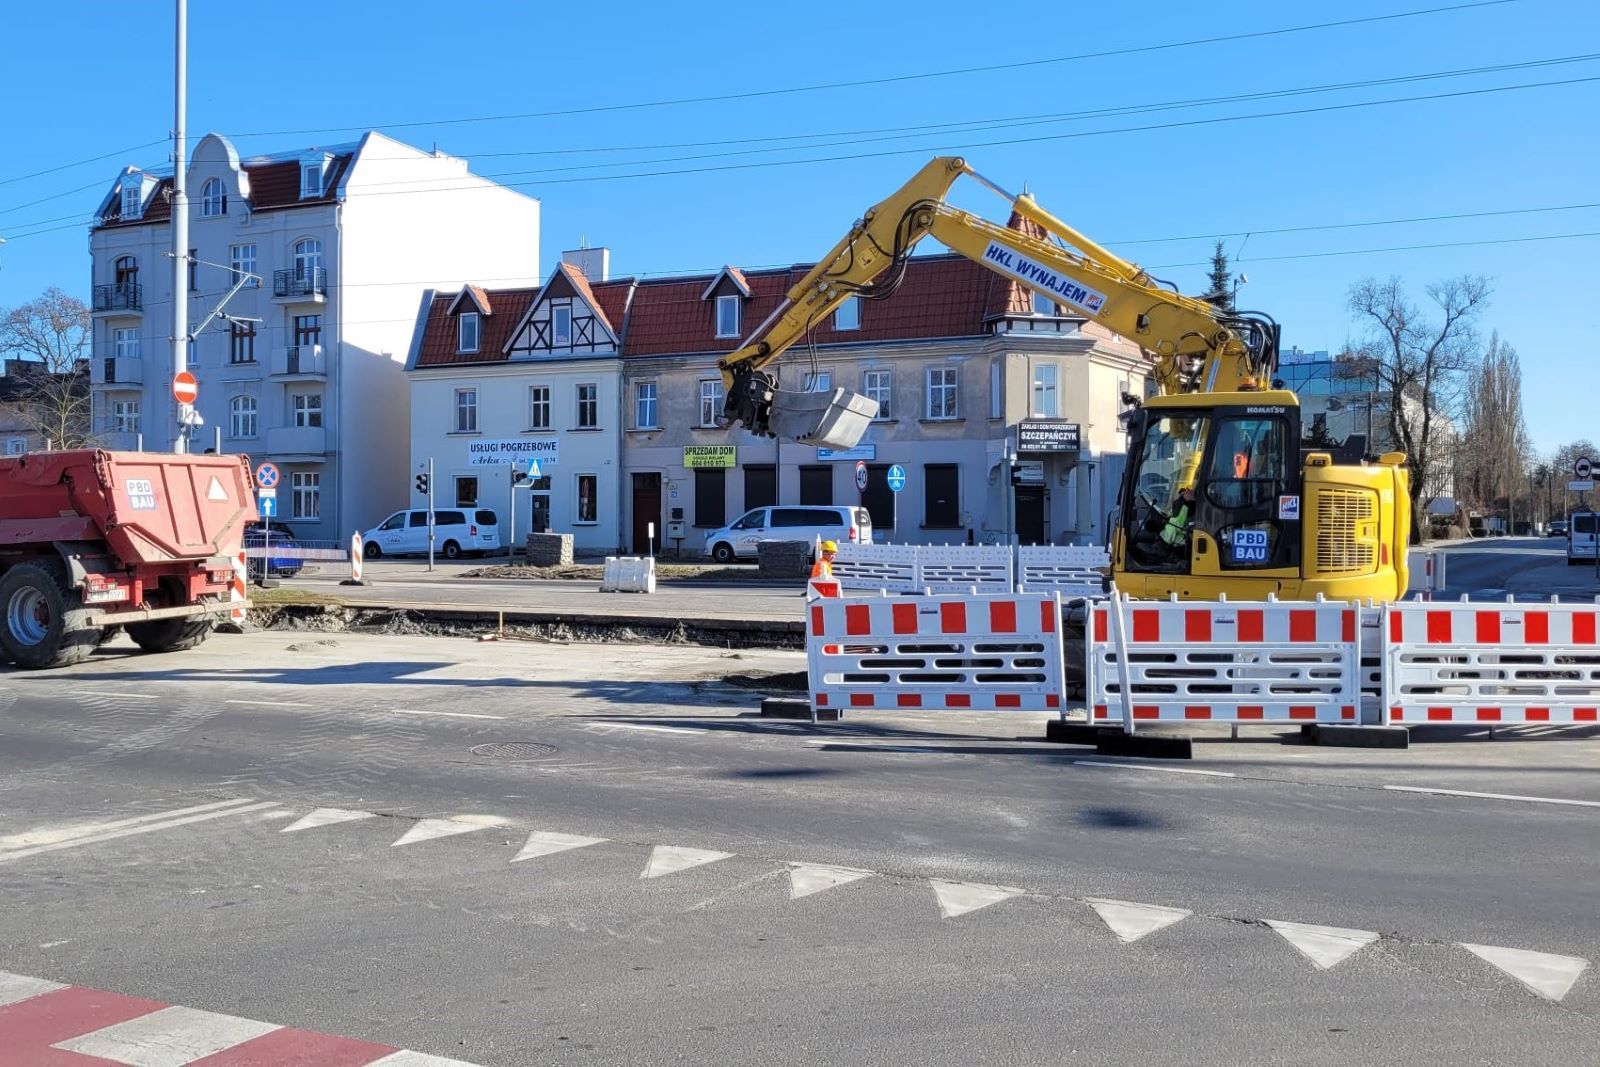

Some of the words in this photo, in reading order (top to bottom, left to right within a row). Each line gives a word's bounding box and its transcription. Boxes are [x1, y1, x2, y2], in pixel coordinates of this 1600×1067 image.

[986, 245, 1012, 268] HKL
[1016, 259, 1087, 304] WYNAJEM
[1247, 406, 1285, 414] KOMATSU
[1021, 430, 1077, 440] SZCZEPAŃCZYK
[471, 443, 498, 453] USŁUGI
[501, 441, 557, 452] POGRZEBOWE
[685, 447, 718, 456] SPRZEDAM
[720, 446, 734, 456] DOM
[472, 456, 500, 465] Arka
[129, 482, 150, 492] PBD
[131, 496, 155, 508] BAU
[1236, 533, 1265, 544] PBD
[1236, 547, 1265, 560] BAU
